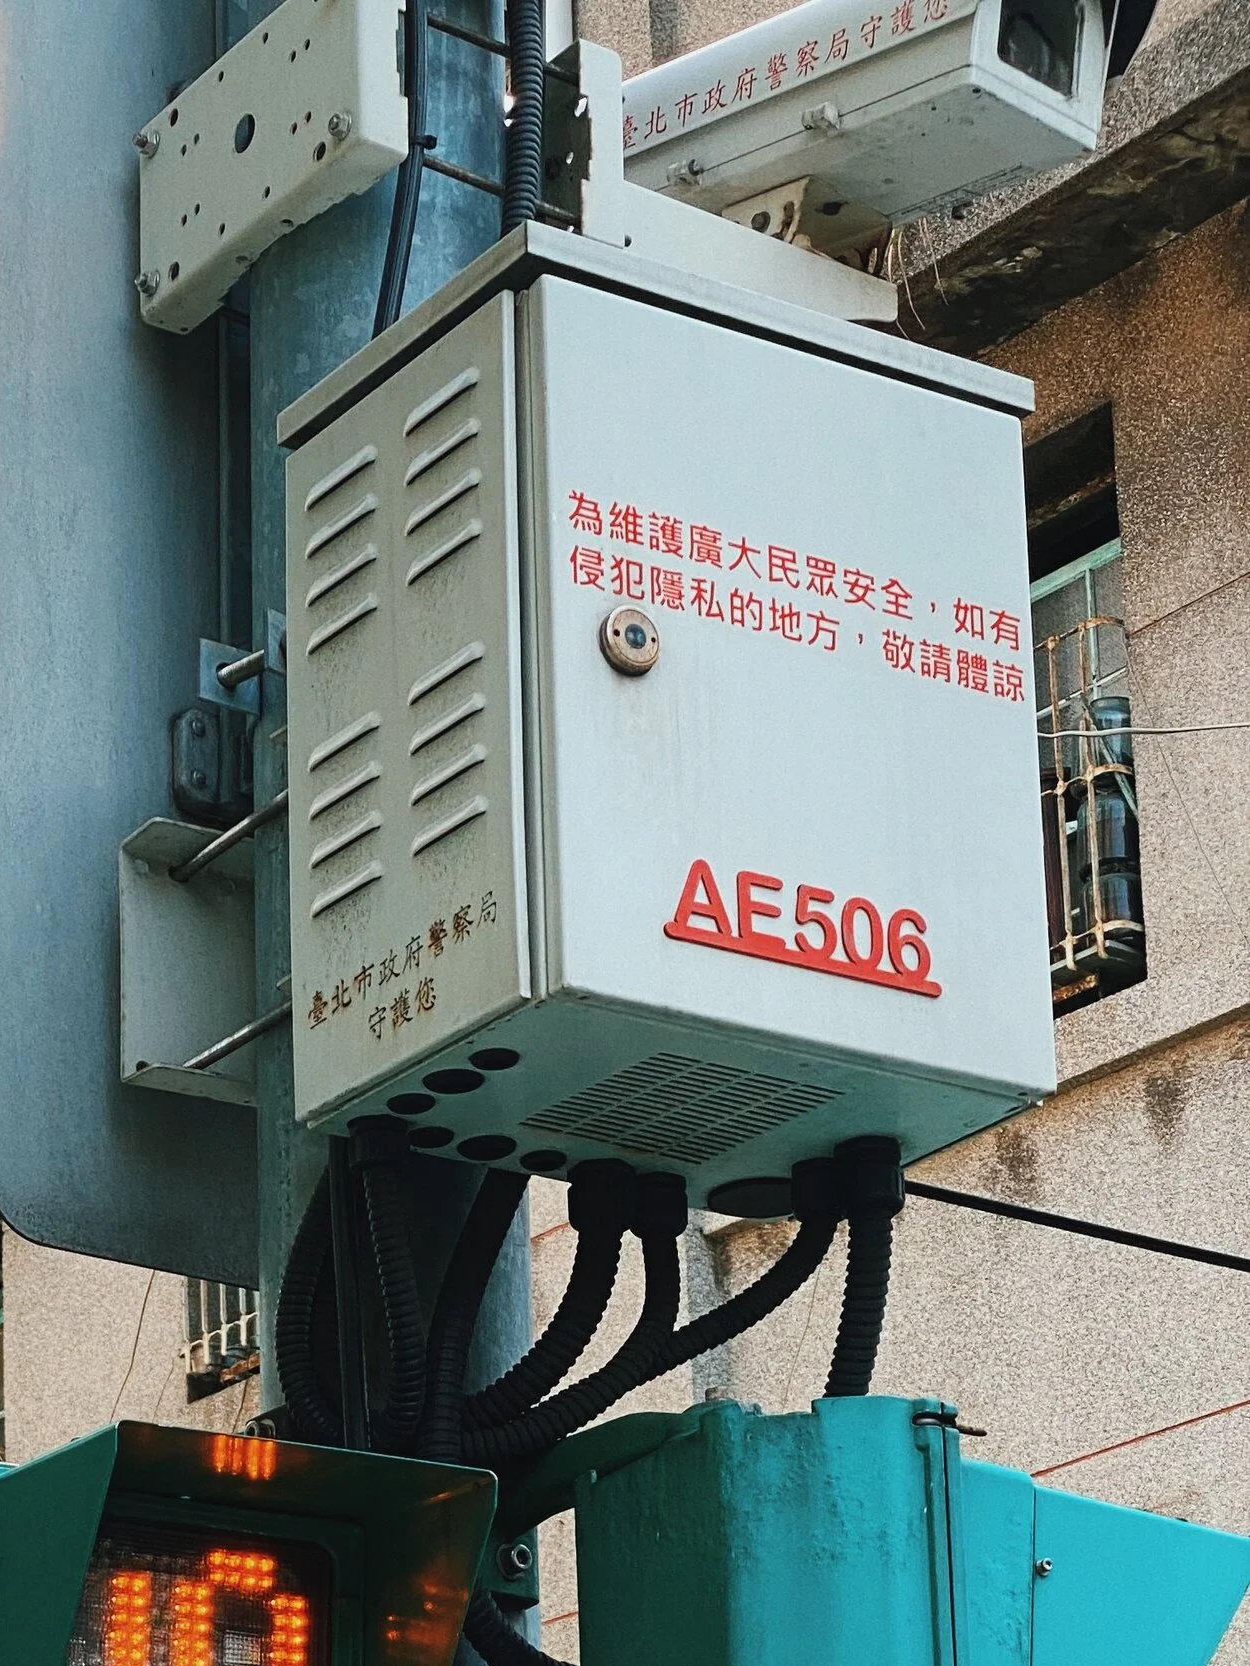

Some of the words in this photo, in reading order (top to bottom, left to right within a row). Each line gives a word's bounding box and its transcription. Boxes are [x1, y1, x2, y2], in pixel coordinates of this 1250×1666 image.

[307, 890, 497, 1030] 臺北市政府警察局
[672, 858, 932, 984] AE506
[367, 976, 437, 1040] 守護您
